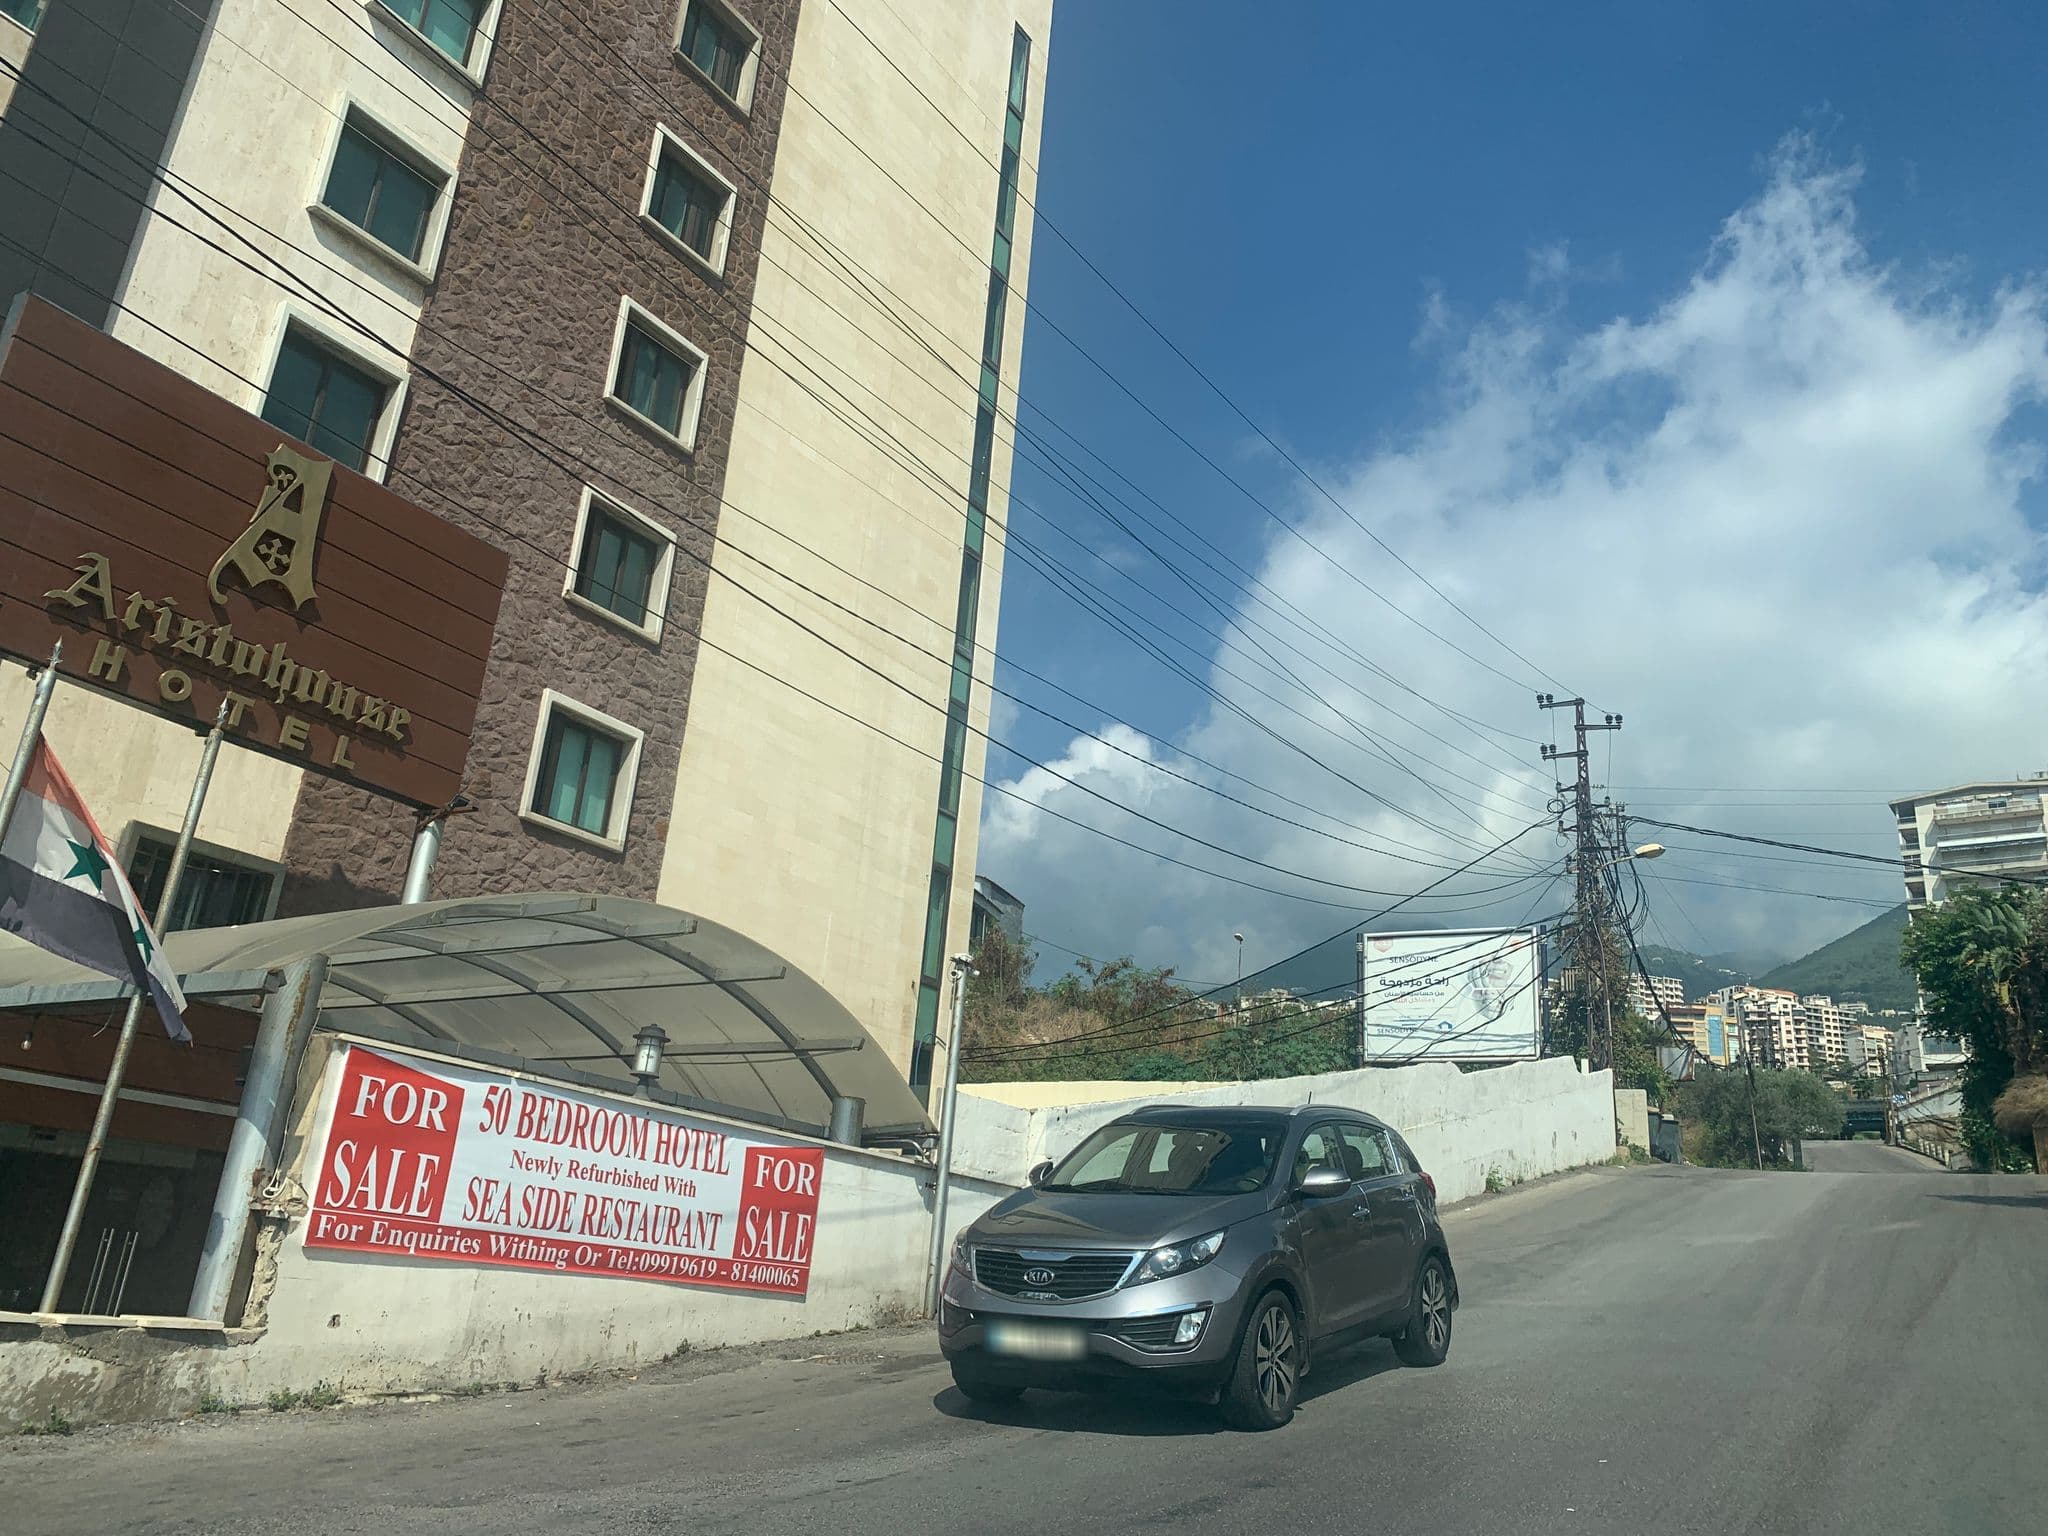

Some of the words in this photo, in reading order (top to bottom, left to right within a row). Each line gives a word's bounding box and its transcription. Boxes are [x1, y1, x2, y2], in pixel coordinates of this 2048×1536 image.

[88, 639, 357, 770] HOTEL
[350, 1074, 448, 1132] FOR
[479, 1085, 512, 1135] 50
[514, 1091, 651, 1161] BEDROOM
[653, 1120, 731, 1175] HOTEL
[324, 1139, 441, 1218] SALE
[509, 1149, 563, 1180] Newly
[566, 1159, 660, 1192] Refurbished
[664, 1175, 697, 1198] With
[753, 1154, 815, 1196] FOR
[462, 1176, 512, 1226] SEA
[517, 1184, 577, 1233] SIDE
[578, 1193, 723, 1251] RESTAURANT
[740, 1205, 811, 1264] SALE
[315, 1214, 363, 1242] For
[368, 1221, 481, 1255] Enquiries
[489, 1234, 570, 1270] Withing
[574, 1244, 602, 1267] Or
[730, 1262, 800, 1287] 81400065
[1029, 1271, 1048, 1282] KIA
